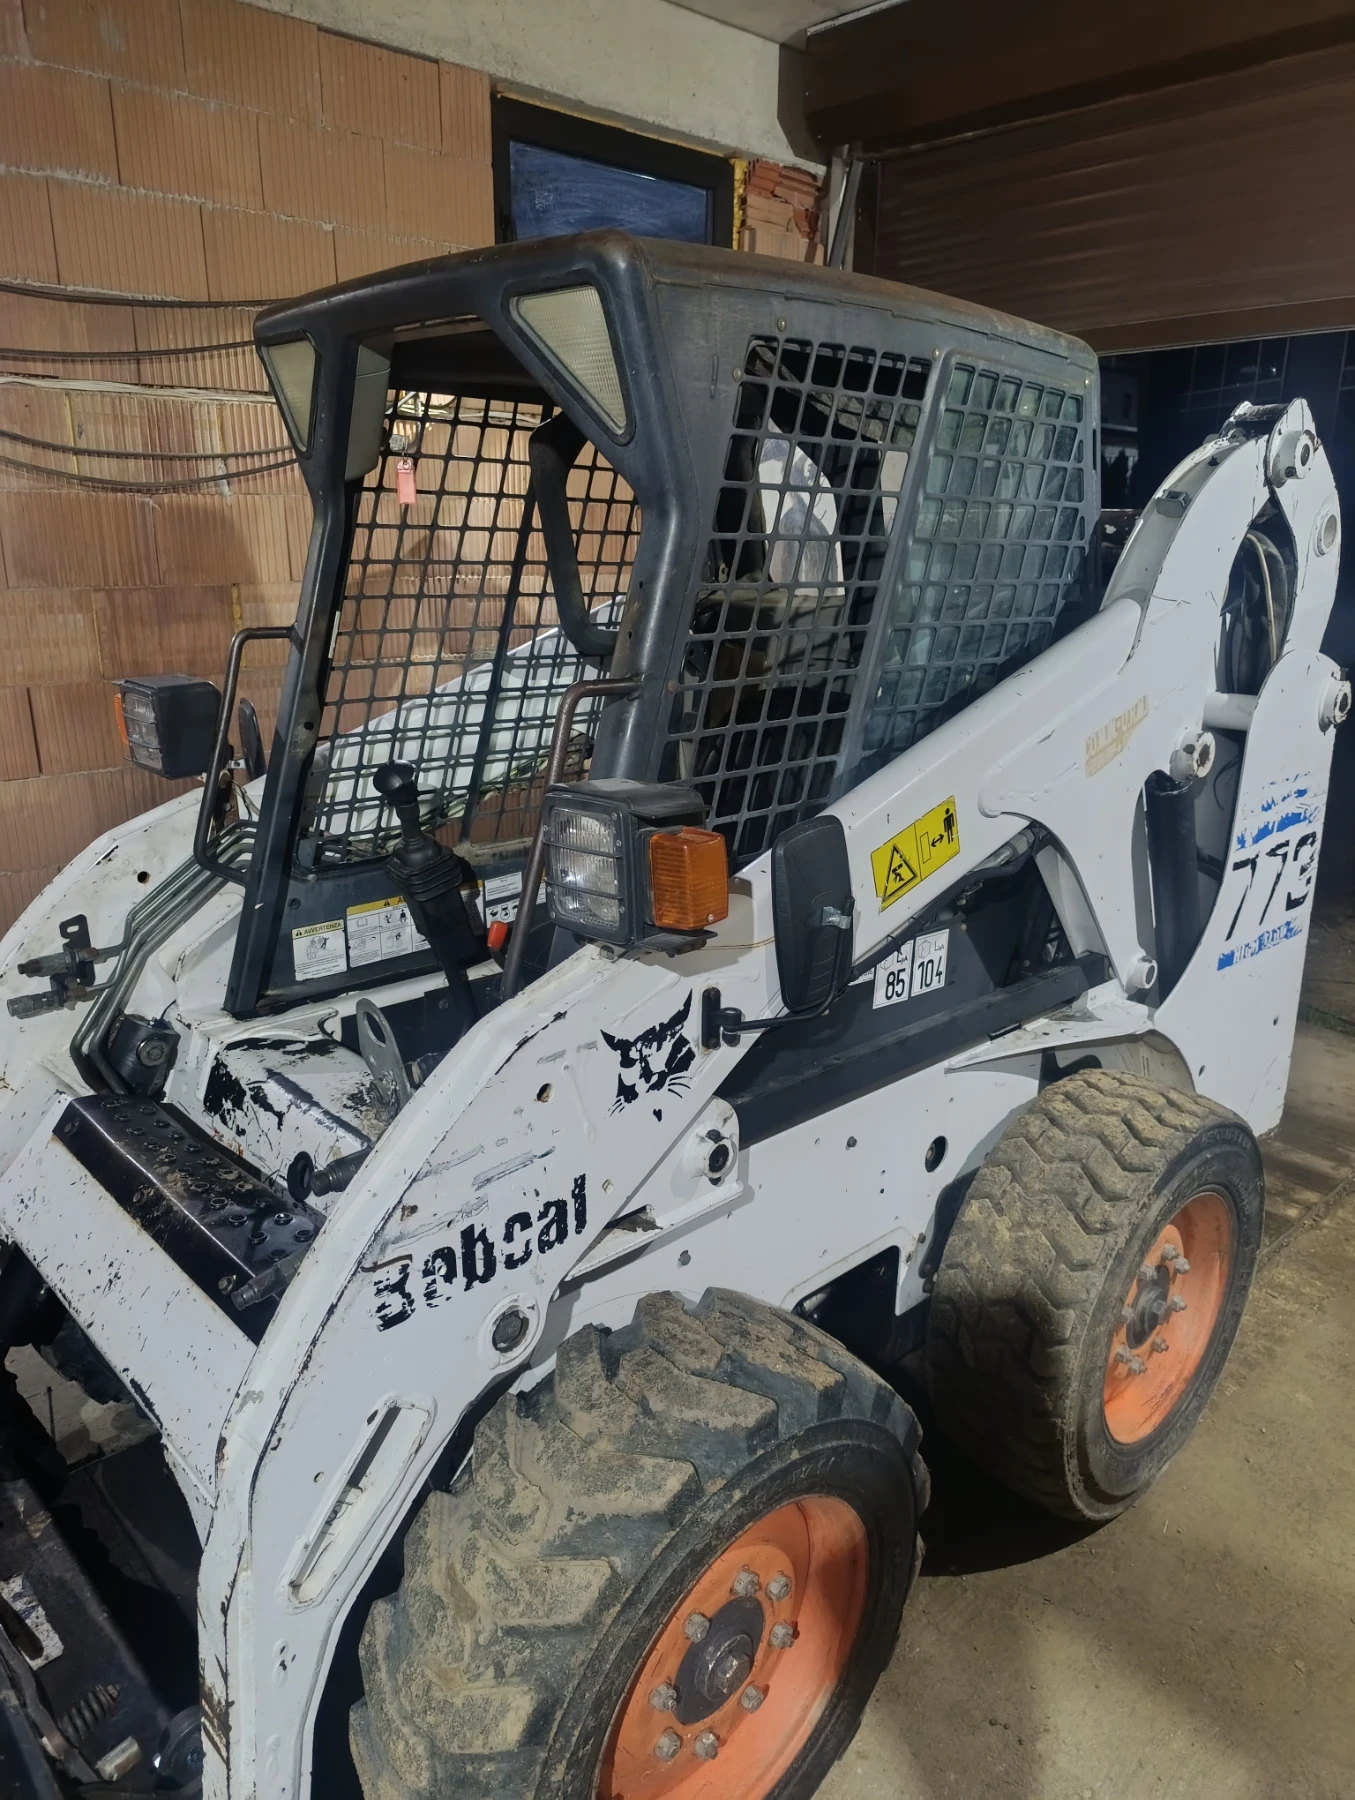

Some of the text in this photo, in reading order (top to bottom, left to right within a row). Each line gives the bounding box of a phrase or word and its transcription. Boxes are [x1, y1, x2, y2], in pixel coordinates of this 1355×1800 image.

[303, 922, 342, 936] AVVERTENZA
[885, 967, 906, 1001] 85
[917, 955, 943, 990] 104
